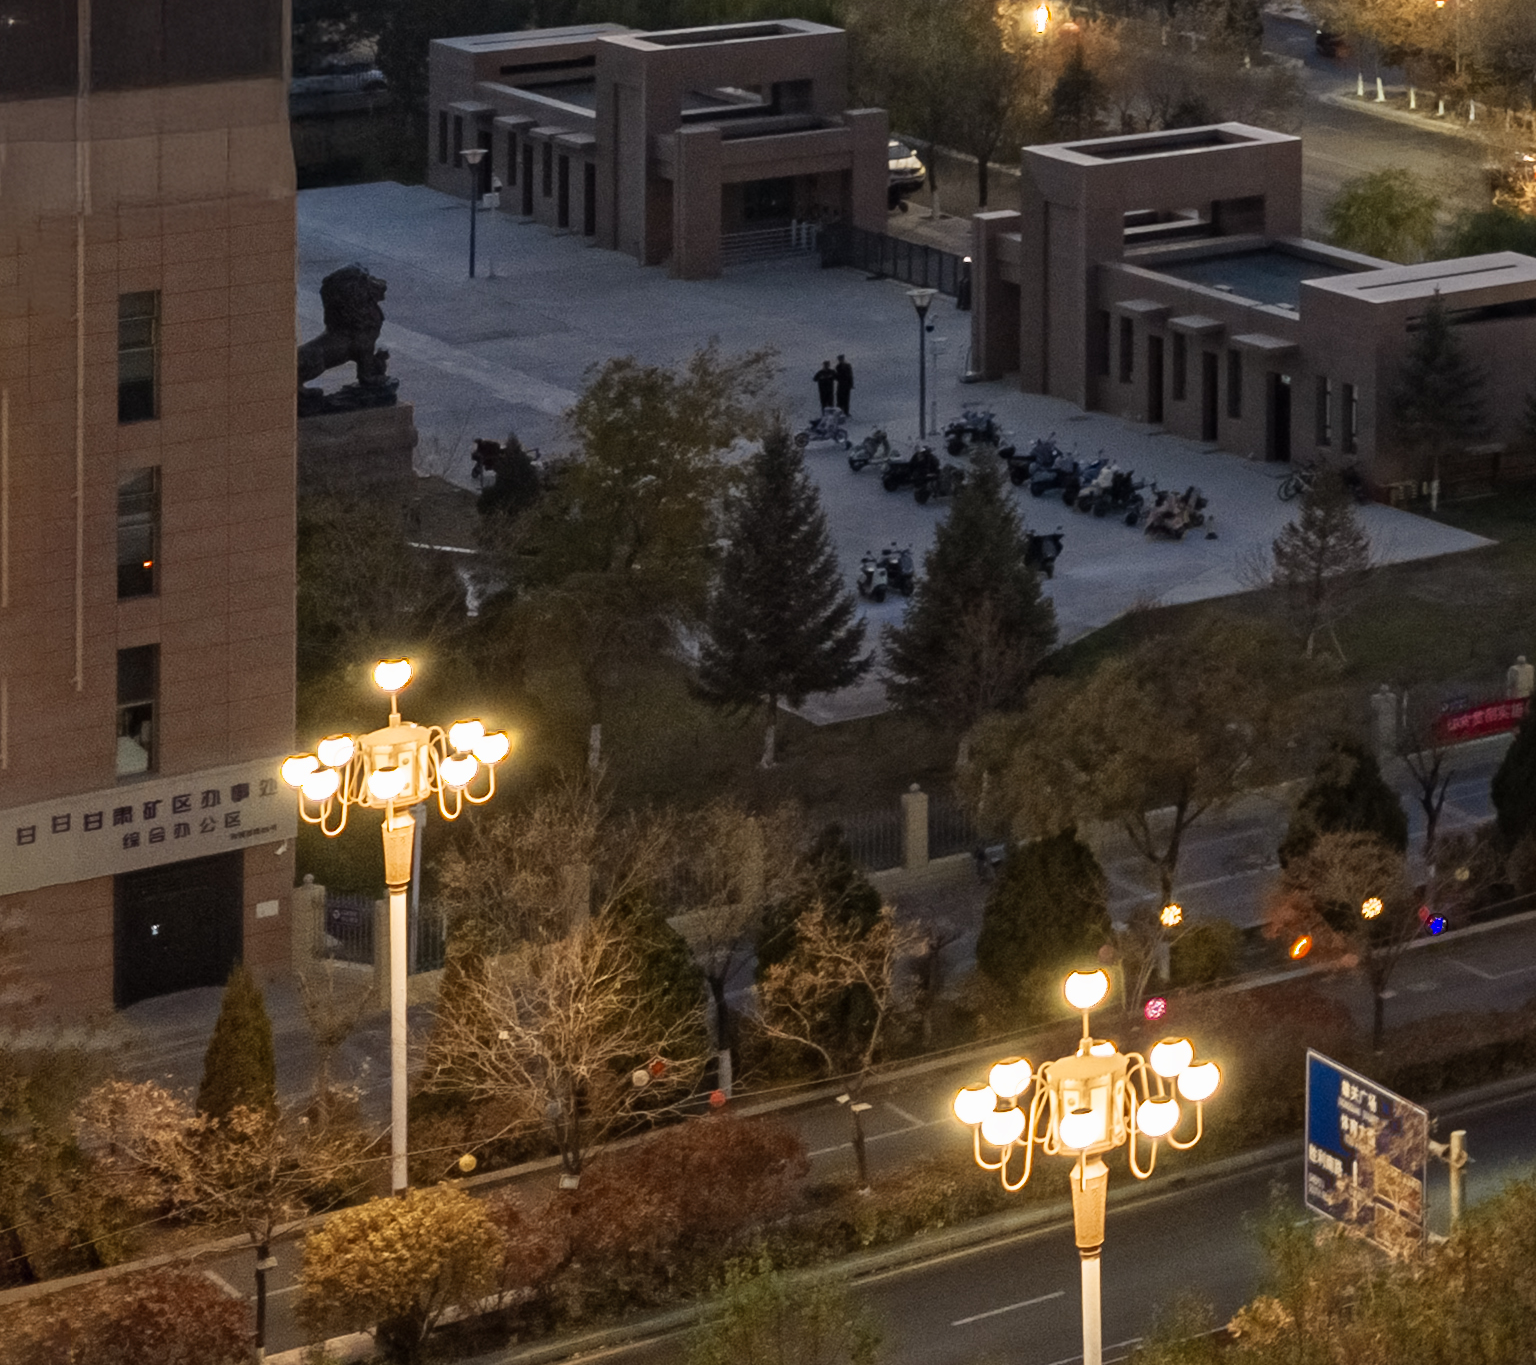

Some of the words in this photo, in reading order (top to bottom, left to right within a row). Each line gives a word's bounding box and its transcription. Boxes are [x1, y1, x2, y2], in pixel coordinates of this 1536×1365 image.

[122, 810, 242, 851] 综合办公区
